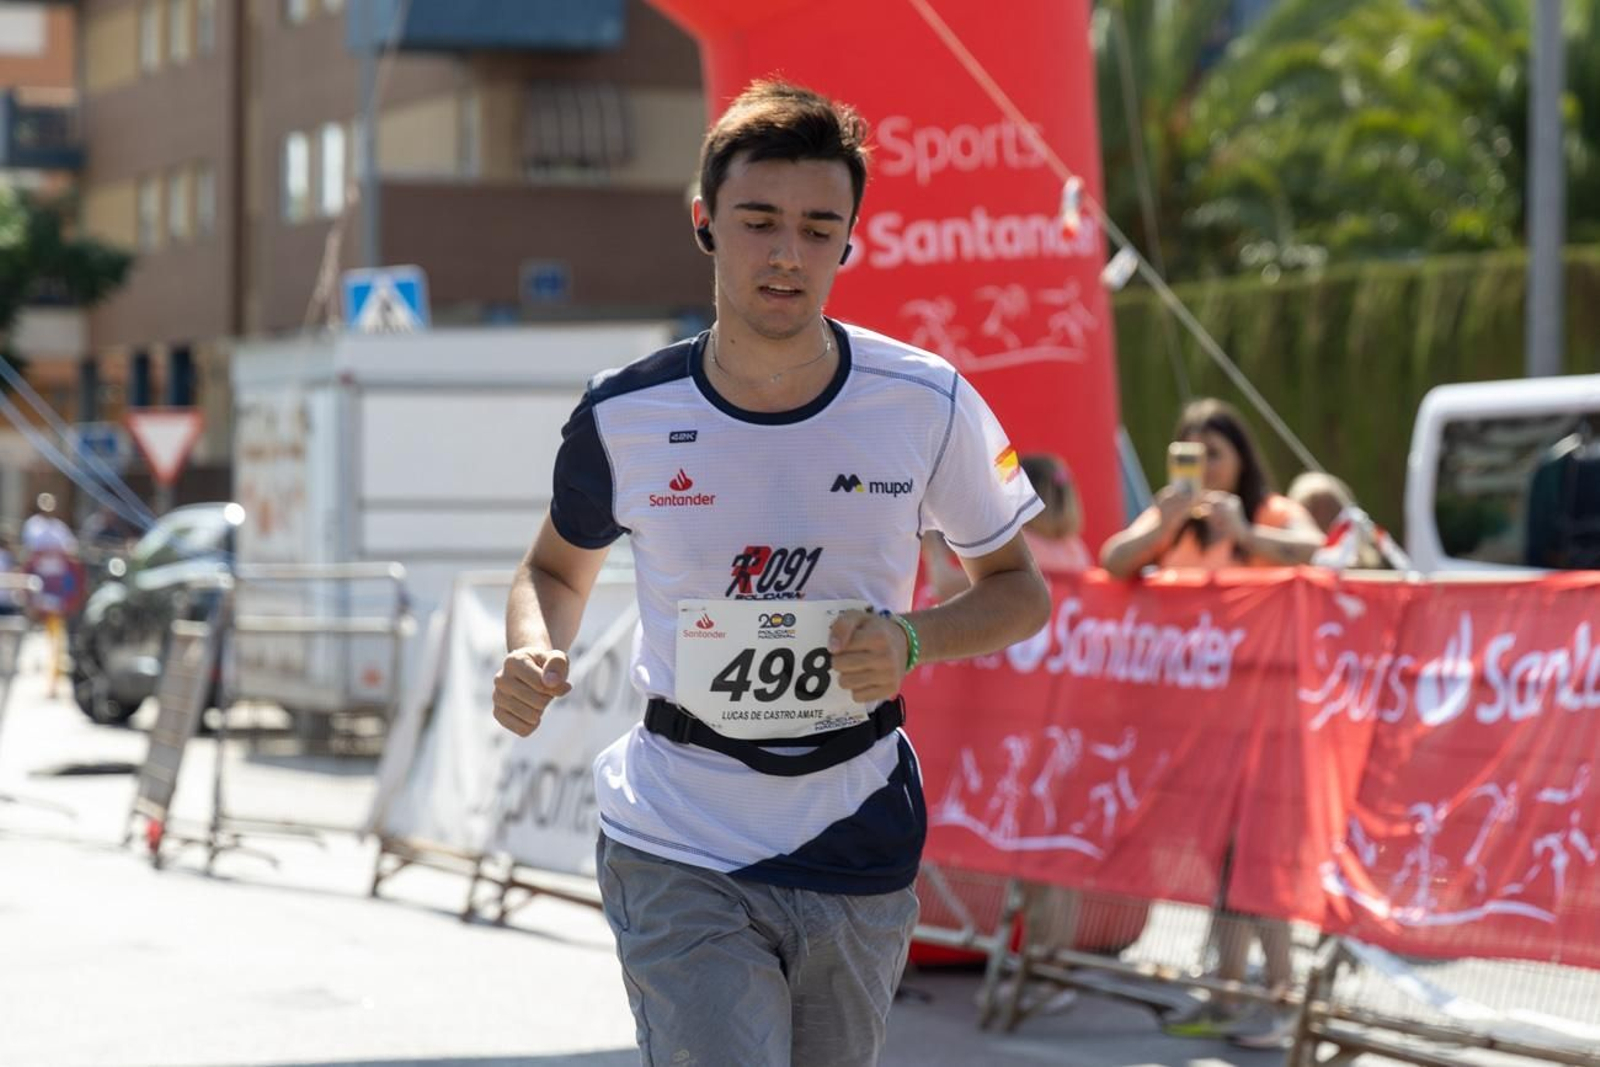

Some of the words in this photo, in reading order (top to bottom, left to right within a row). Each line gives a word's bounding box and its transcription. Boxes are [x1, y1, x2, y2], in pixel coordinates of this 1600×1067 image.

[876, 116, 1047, 185] Sports
[869, 477, 914, 498] mupol
[649, 493, 716, 507] Santander
[682, 629, 727, 640] Santander
[1047, 596, 1248, 690] Santander
[709, 647, 833, 703] 498
[721, 710, 749, 721] LUCAS
[750, 710, 762, 720] DE
[763, 710, 796, 720] CASTRO
[797, 709, 823, 719] AMATE
